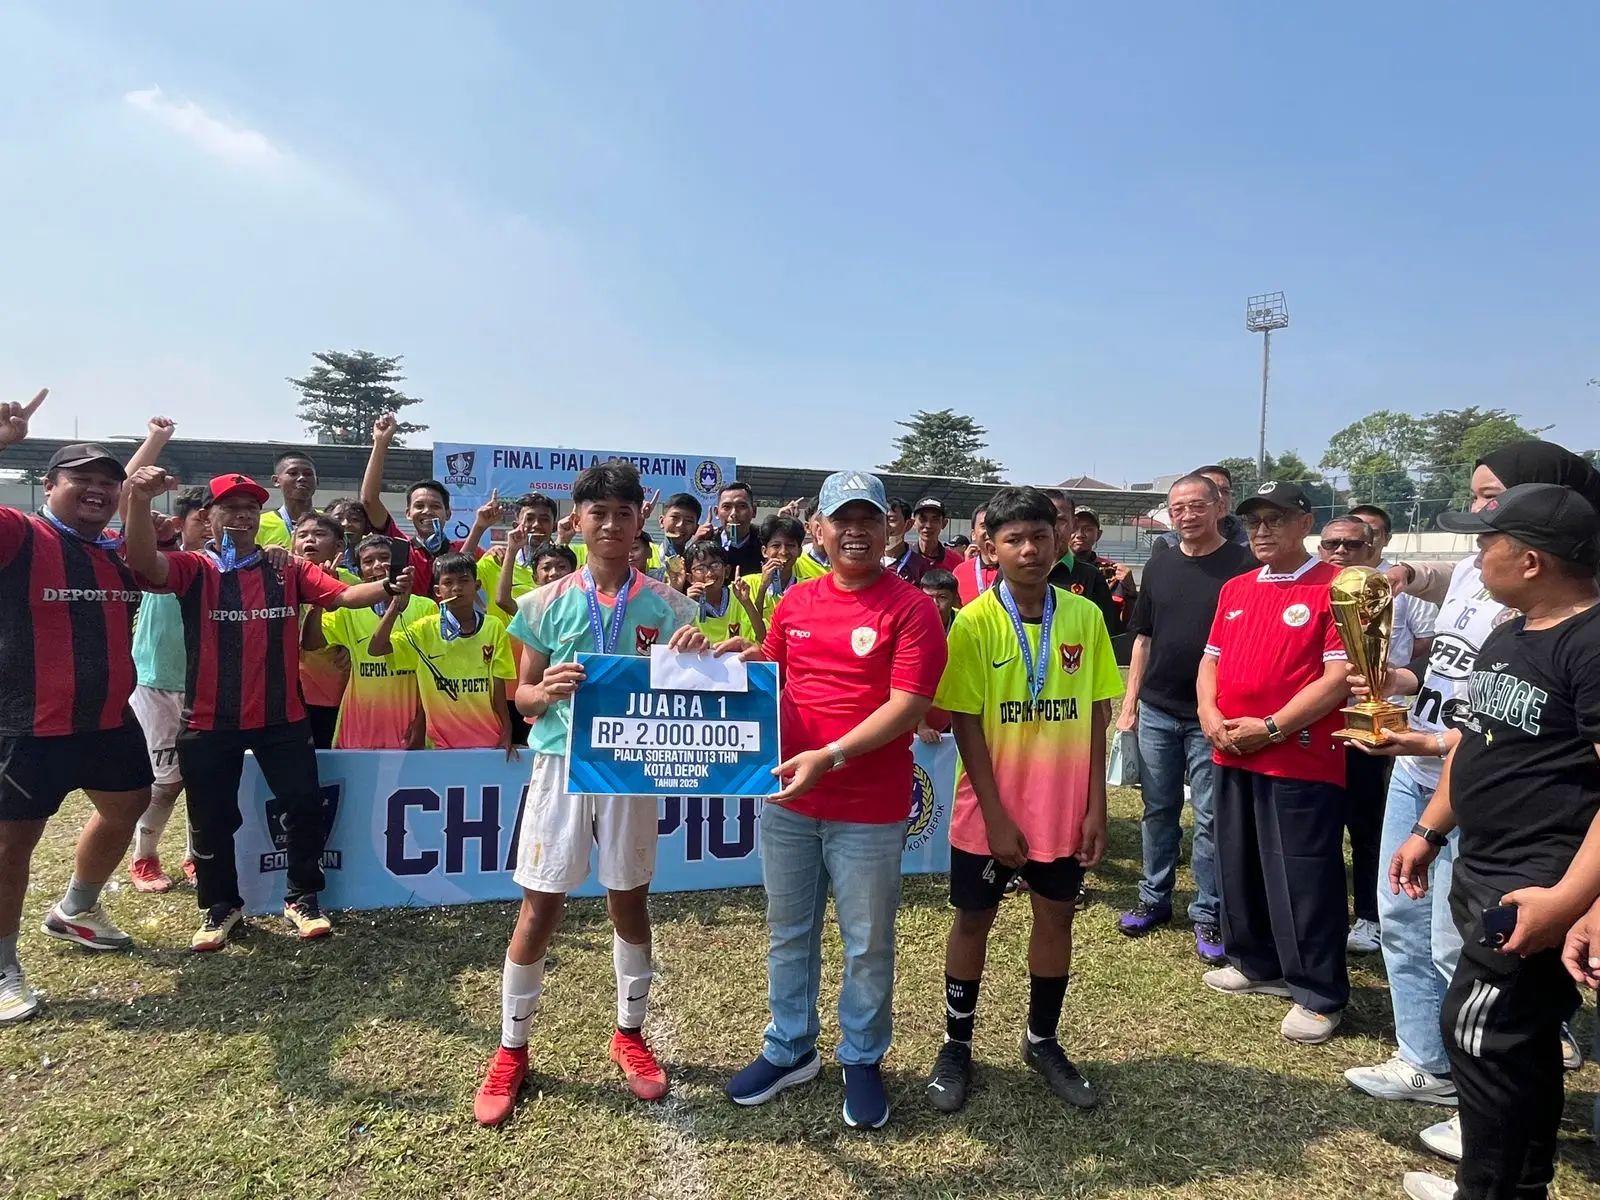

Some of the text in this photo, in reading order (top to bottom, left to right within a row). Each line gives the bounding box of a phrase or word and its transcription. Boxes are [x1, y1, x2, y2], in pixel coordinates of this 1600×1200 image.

[493, 449, 687, 477] FINAL PIALA ERATIN
[529, 482, 572, 491] ASOSIASI
[43, 588, 143, 603] DEPOK POET
[1454, 606, 1477, 631] 16
[359, 662, 388, 677] DEPOK
[626, 692, 727, 718] JUARA 1
[1000, 700, 1034, 725] DEPOK
[597, 721, 754, 750] RP. 2.000.000,-
[152, 747, 176, 767] 77
[613, 749, 738, 764] PIALA SOERATIN U13 THN
[643, 763, 709, 778] KOTA DEPOK
[654, 778, 699, 788] TAHUN 2025
[907, 803, 945, 852] KOTA DEPOK
[982, 858, 996, 884] 4
